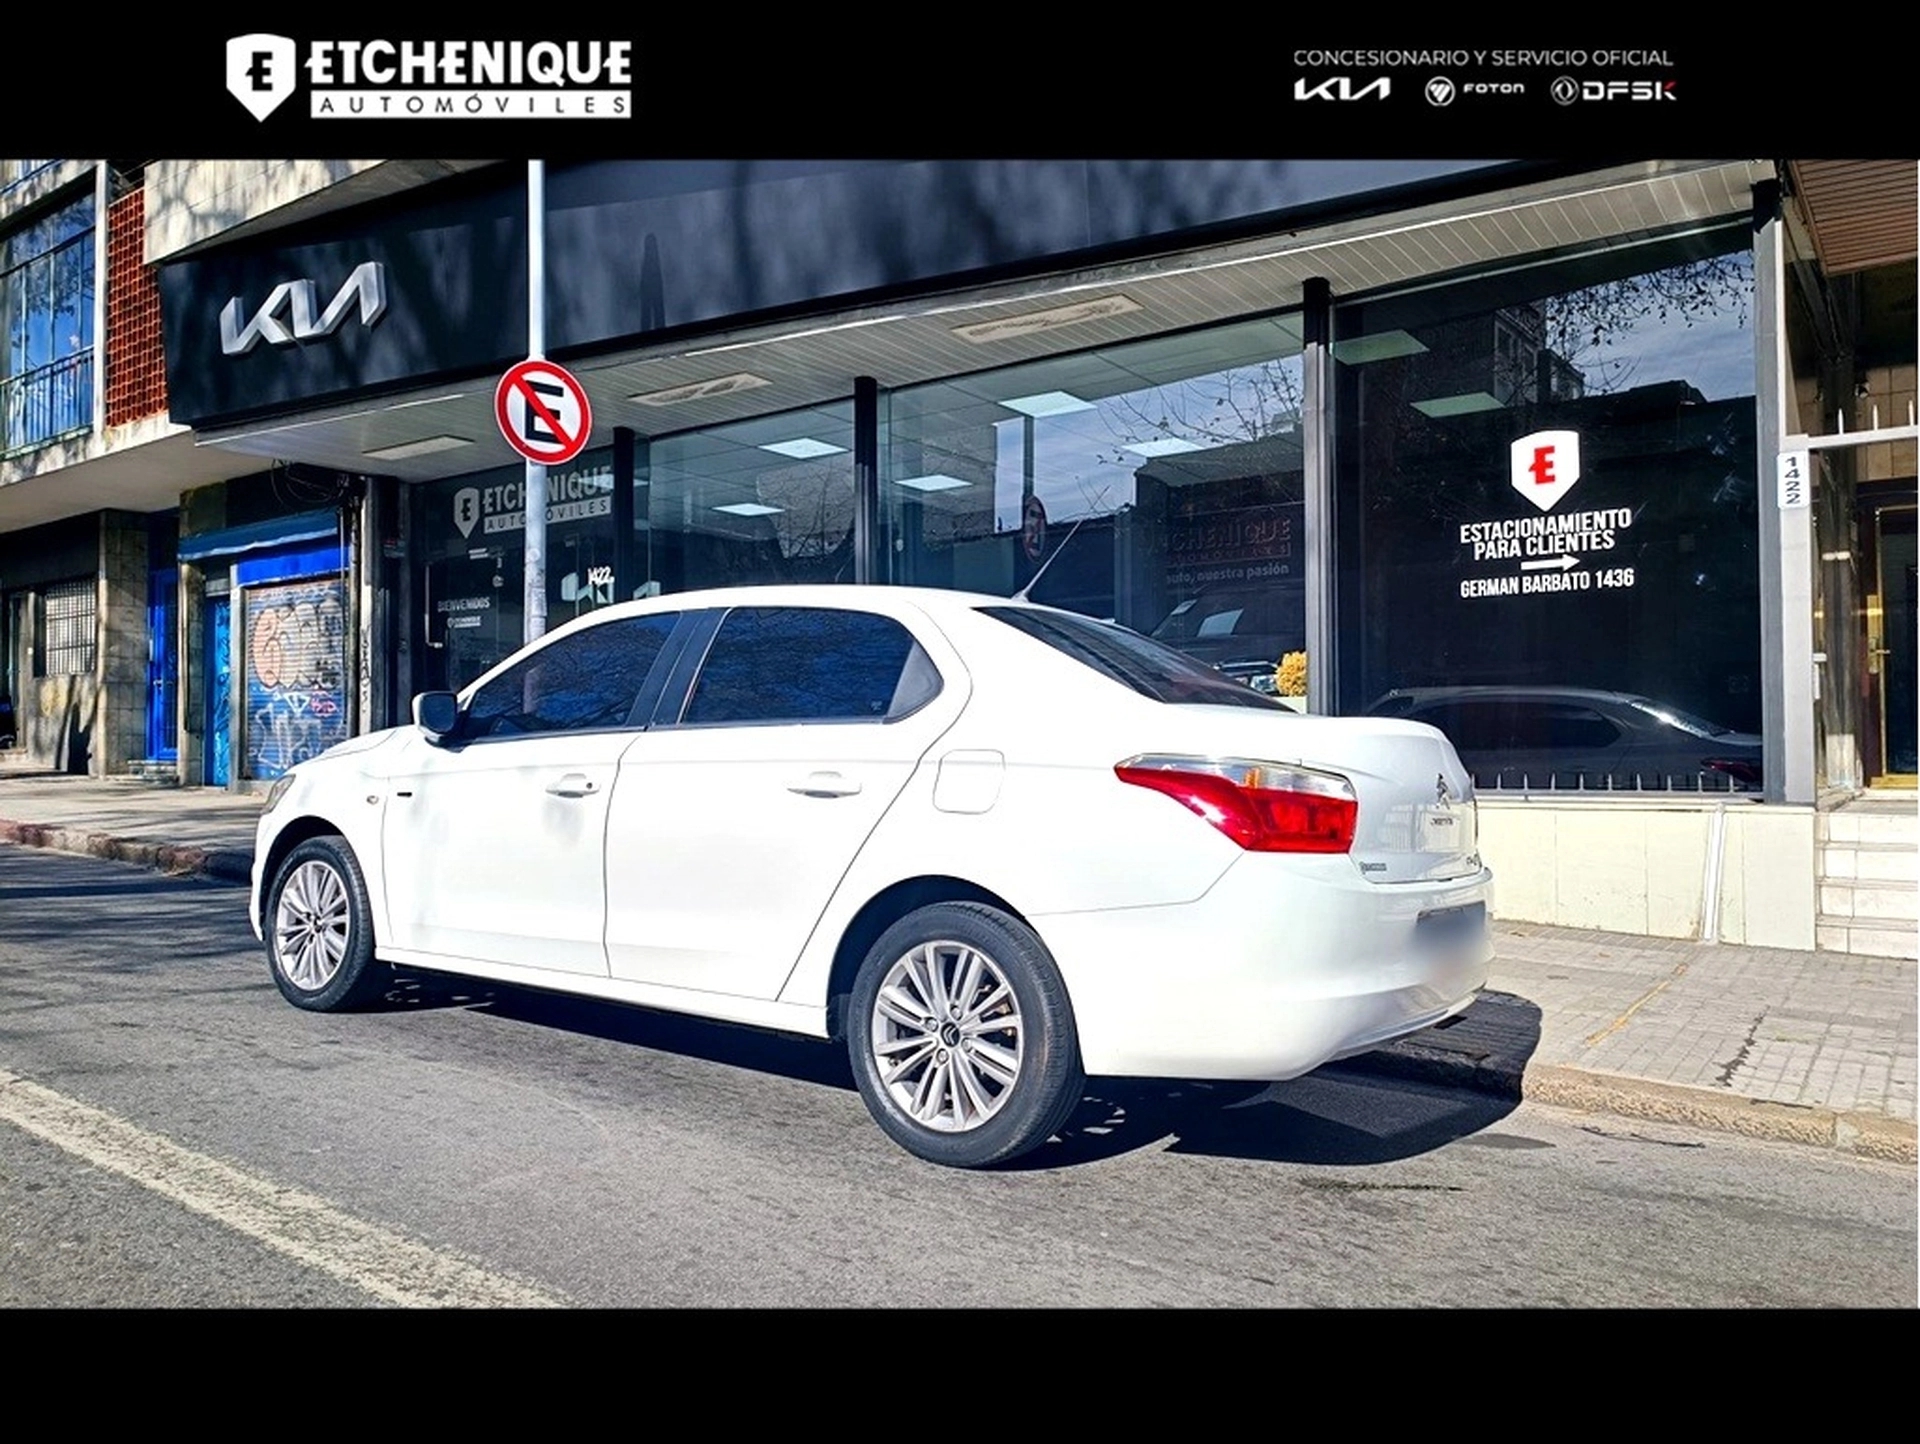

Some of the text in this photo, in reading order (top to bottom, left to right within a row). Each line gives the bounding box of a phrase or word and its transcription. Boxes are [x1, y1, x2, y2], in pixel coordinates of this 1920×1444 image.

[219, 261, 388, 356] KIA
[482, 465, 611, 513] ETCHNIQUE
[1784, 456, 1801, 505] 1422
[1460, 507, 1632, 544] ESTACIONAMIENTO
[1474, 529, 1616, 560] PARA CLIENTES
[1246, 562, 1290, 580] pasión
[1460, 568, 1635, 599] GERMAN BARBATO 1436
